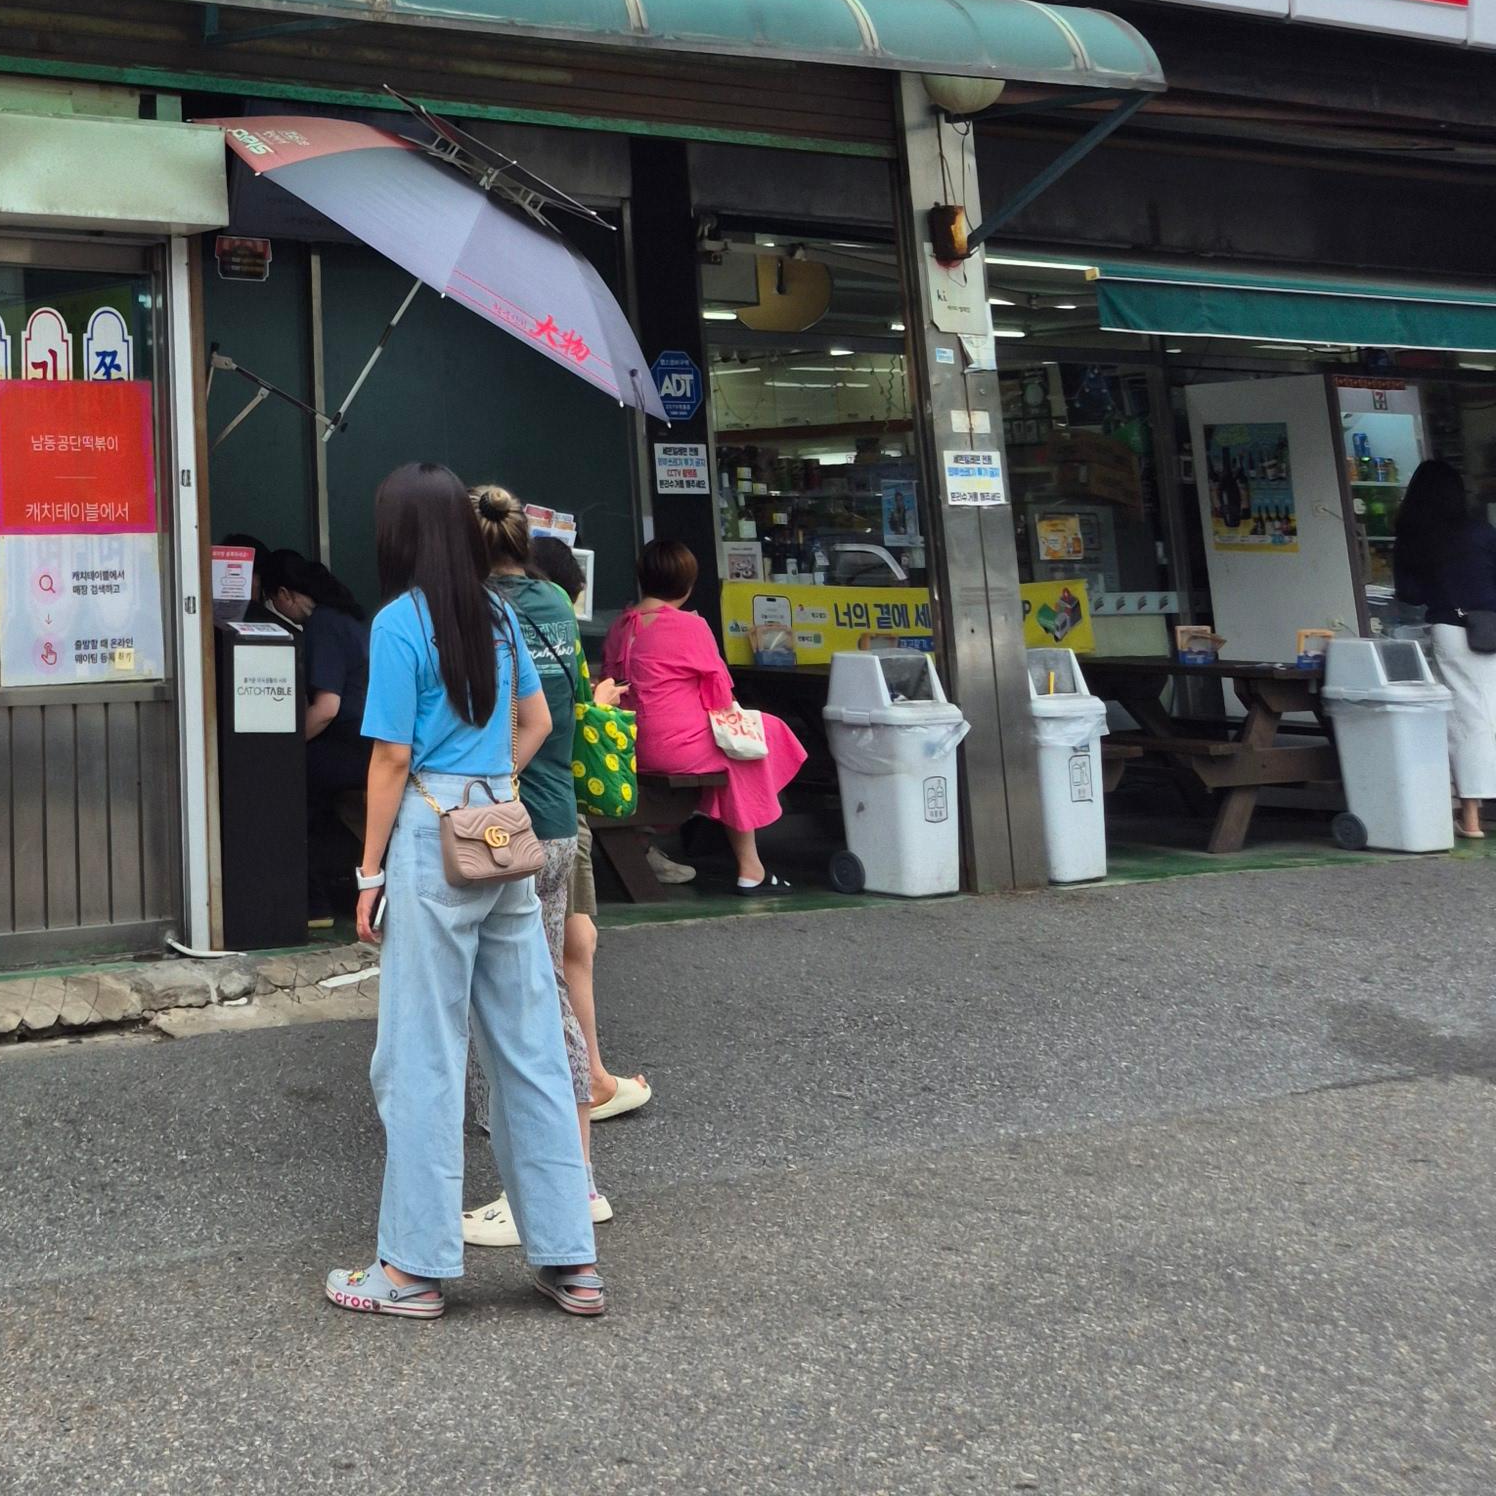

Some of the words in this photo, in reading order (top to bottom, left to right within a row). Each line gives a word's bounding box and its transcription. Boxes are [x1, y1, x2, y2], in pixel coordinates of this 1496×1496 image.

[660, 373, 695, 398] ADT
[31, 434, 119, 452] 남동공단떡볶이
[25, 501, 129, 523] 캐치테이블에서
[72, 569, 125, 581] 캐치테이블에서
[72, 584, 88, 595] 매장
[90, 584, 120, 595] 검색하고
[833, 602, 871, 630] 너의
[873, 603, 911, 630] 곁에
[74, 639, 98, 650] 출발할
[110, 637, 134, 649] 온라인
[74, 653, 98, 665] 웨이팅
